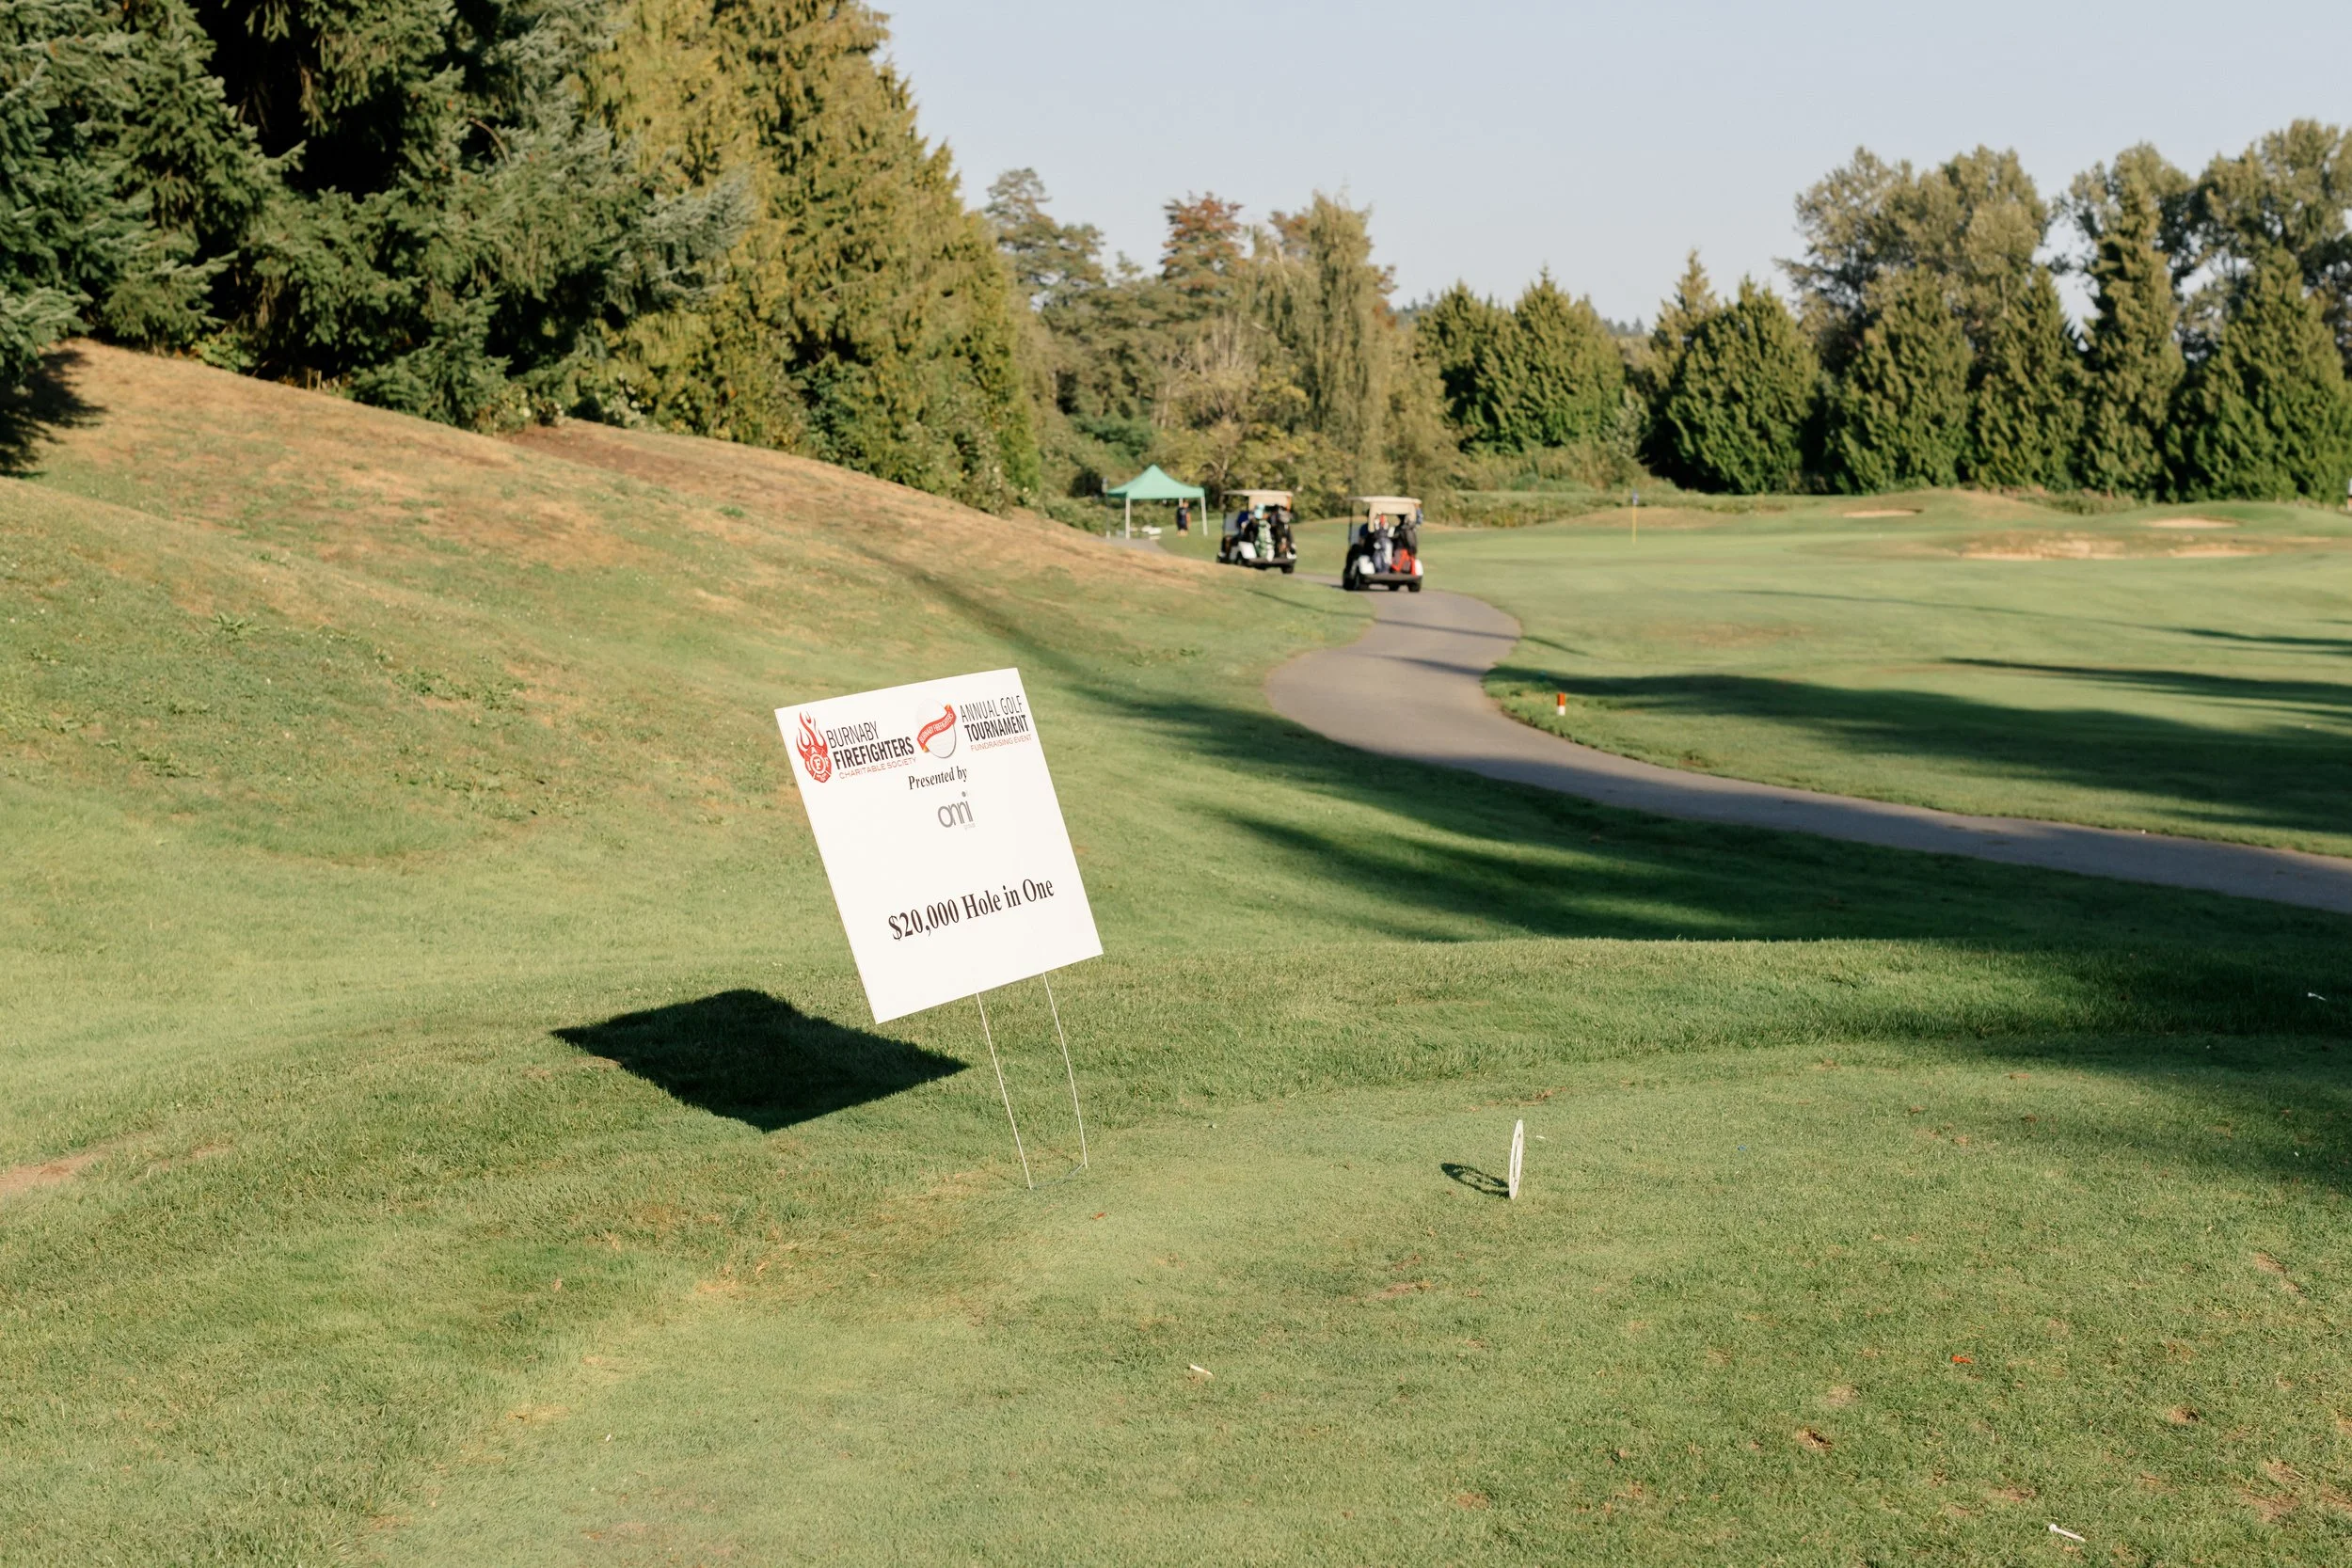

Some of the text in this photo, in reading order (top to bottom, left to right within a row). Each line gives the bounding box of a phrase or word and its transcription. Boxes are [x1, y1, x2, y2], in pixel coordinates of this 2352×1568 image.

[960, 695, 1024, 723] ANNUAL GOLF
[826, 721, 880, 749] BURNABY
[964, 715, 1029, 743] TOURNAMENT
[971, 734, 1033, 752] FUNDRAISING EVENT
[833, 736, 914, 770] FIREFIGHTERS
[838, 764, 885, 780] CHARITABLE
[887, 756, 917, 769] SOCIETY
[908, 766, 968, 790] Presented by
[888, 879, 1055, 941] $20,000 Hole in One
